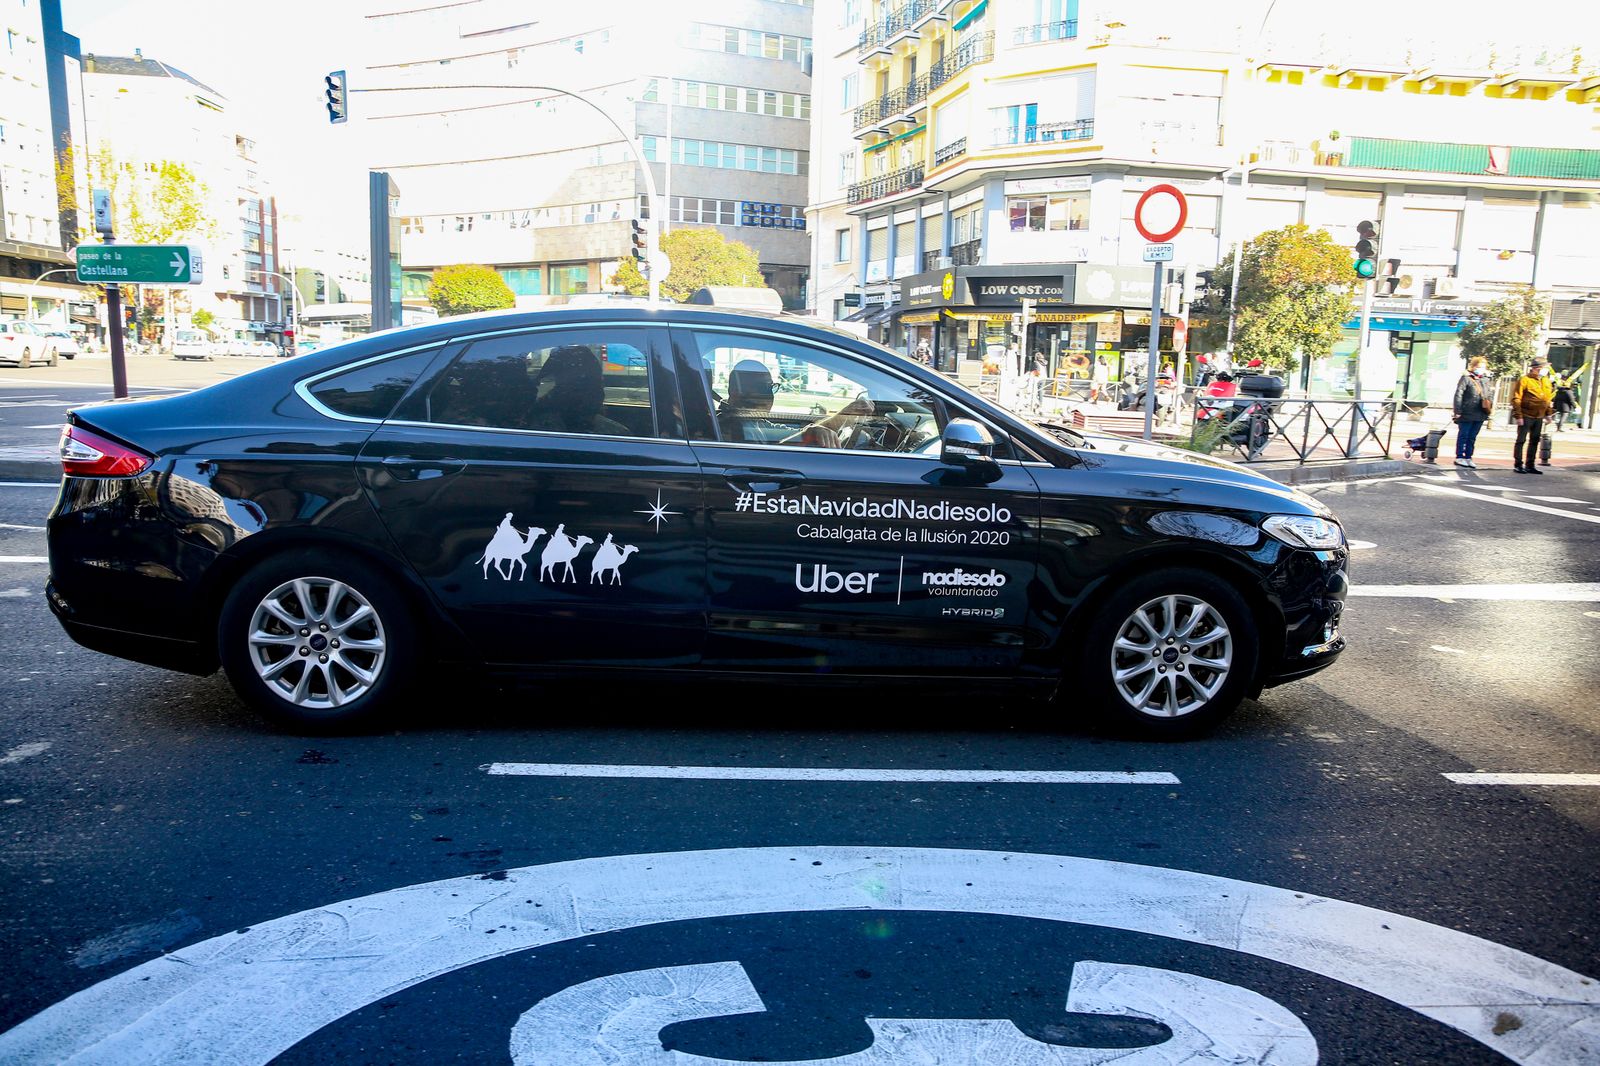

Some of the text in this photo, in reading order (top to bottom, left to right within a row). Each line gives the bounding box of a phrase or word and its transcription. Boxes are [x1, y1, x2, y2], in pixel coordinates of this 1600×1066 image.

[79, 251, 122, 262] paseo de la
[80, 265, 128, 276] Castellana
[981, 285, 1008, 295] LOW
[735, 492, 1012, 524] #EstaNavidadNadiesolo
[796, 523, 1010, 546] Cabalgata de la Ilusión 2020
[795, 563, 880, 594] Uber
[921, 568, 1006, 587] nadiesolo
[928, 587, 999, 598] voluntariado
[942, 607, 994, 618] HYBRID
